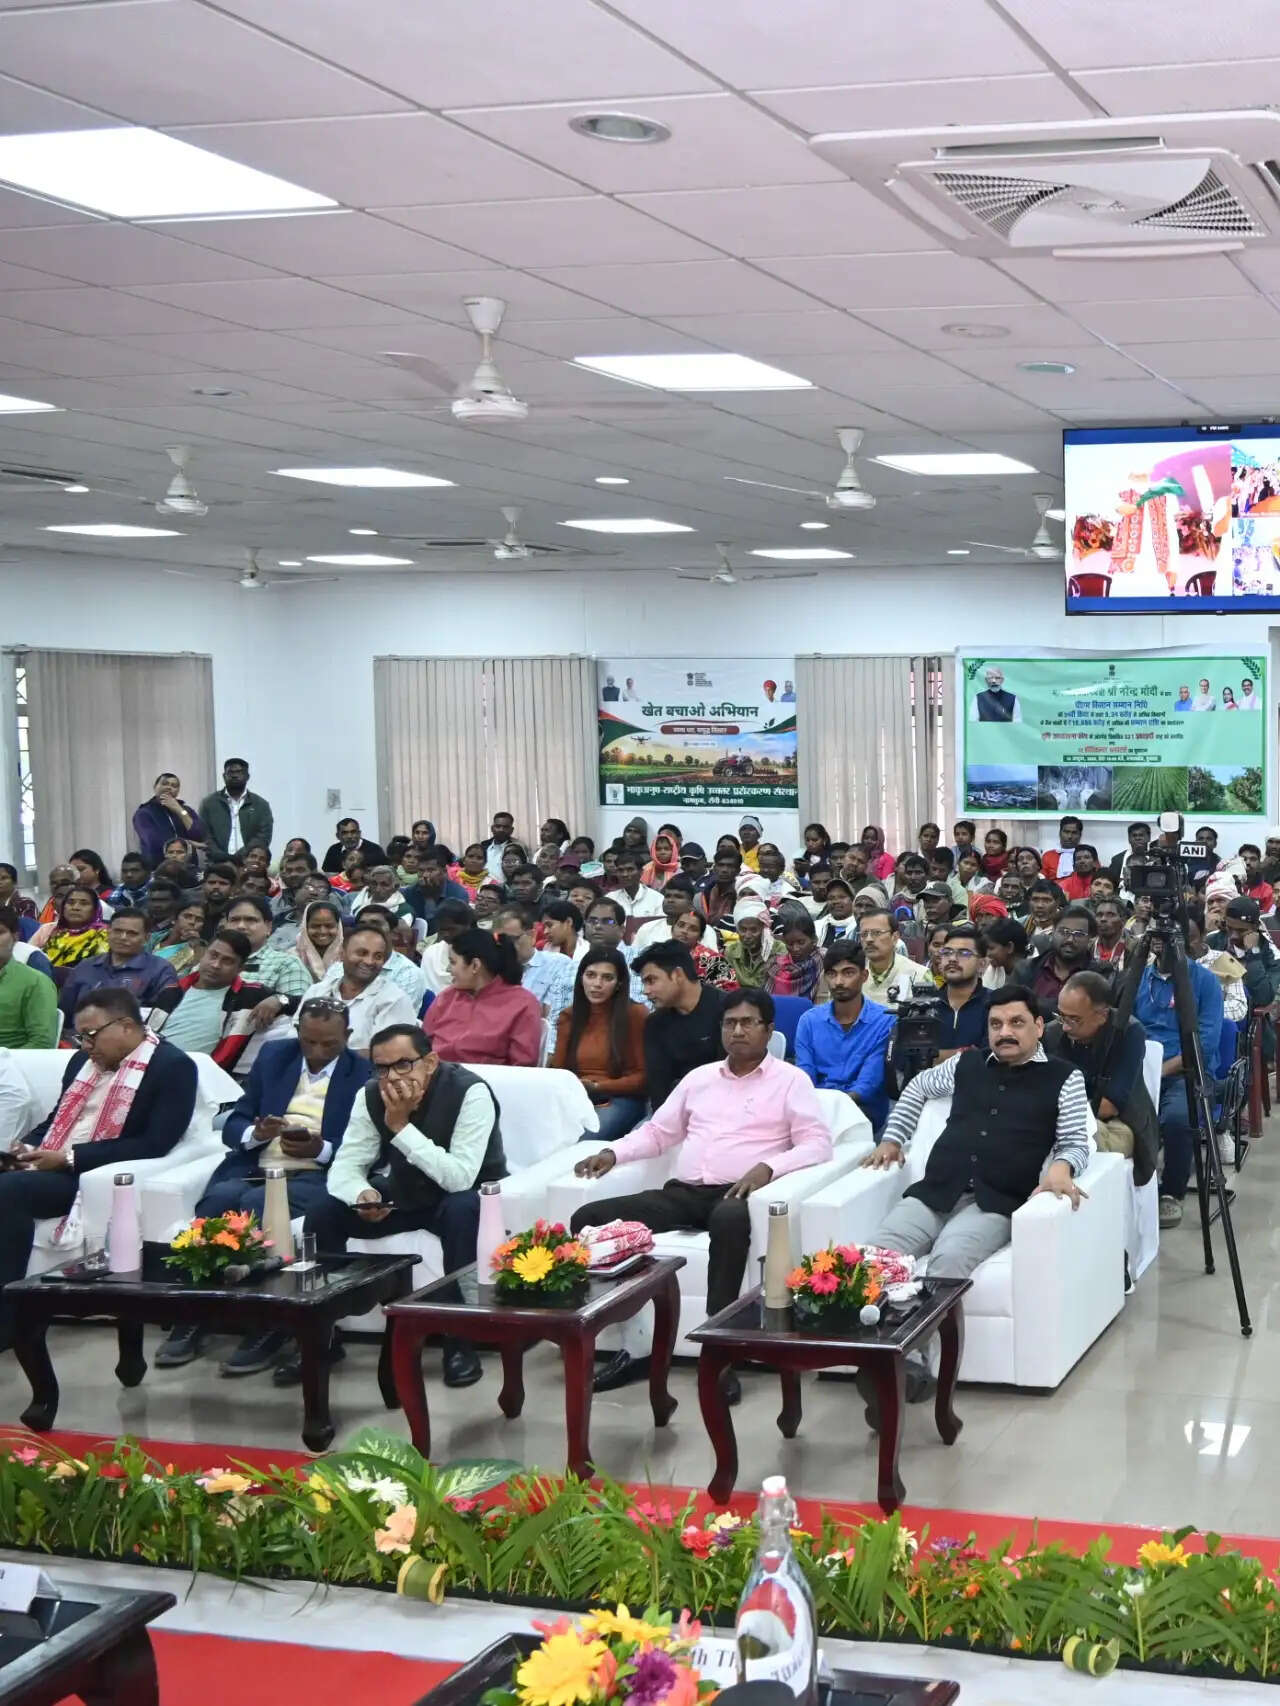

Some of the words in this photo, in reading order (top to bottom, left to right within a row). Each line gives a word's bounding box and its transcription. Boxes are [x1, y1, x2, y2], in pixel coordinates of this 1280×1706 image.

[641, 702, 663, 717] खेत
[666, 702, 706, 717] बचाओ
[709, 702, 759, 717] अभियान
[1182, 846, 1204, 856] ANI
